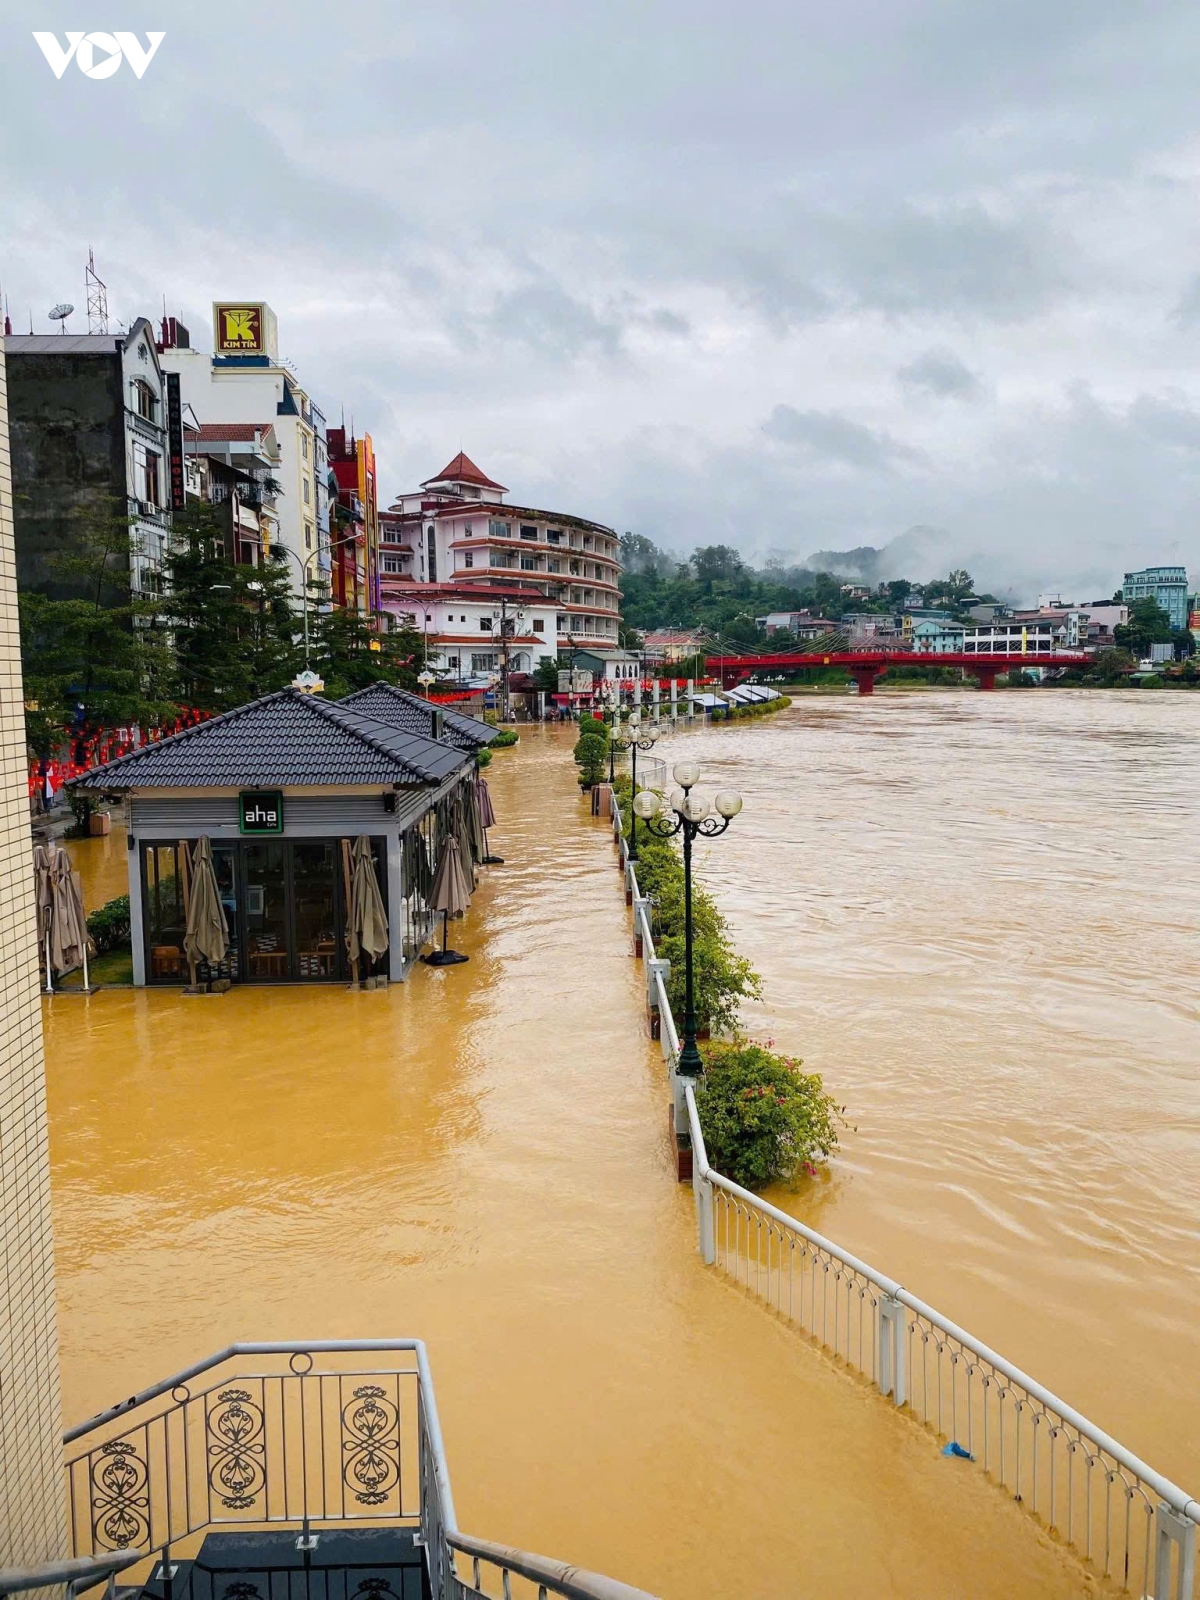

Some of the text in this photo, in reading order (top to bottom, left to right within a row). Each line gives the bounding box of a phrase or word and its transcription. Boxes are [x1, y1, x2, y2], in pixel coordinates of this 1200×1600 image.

[241, 339, 257, 348] TÍN
[172, 456, 182, 507] HOTEL
[245, 804, 277, 822] aha
